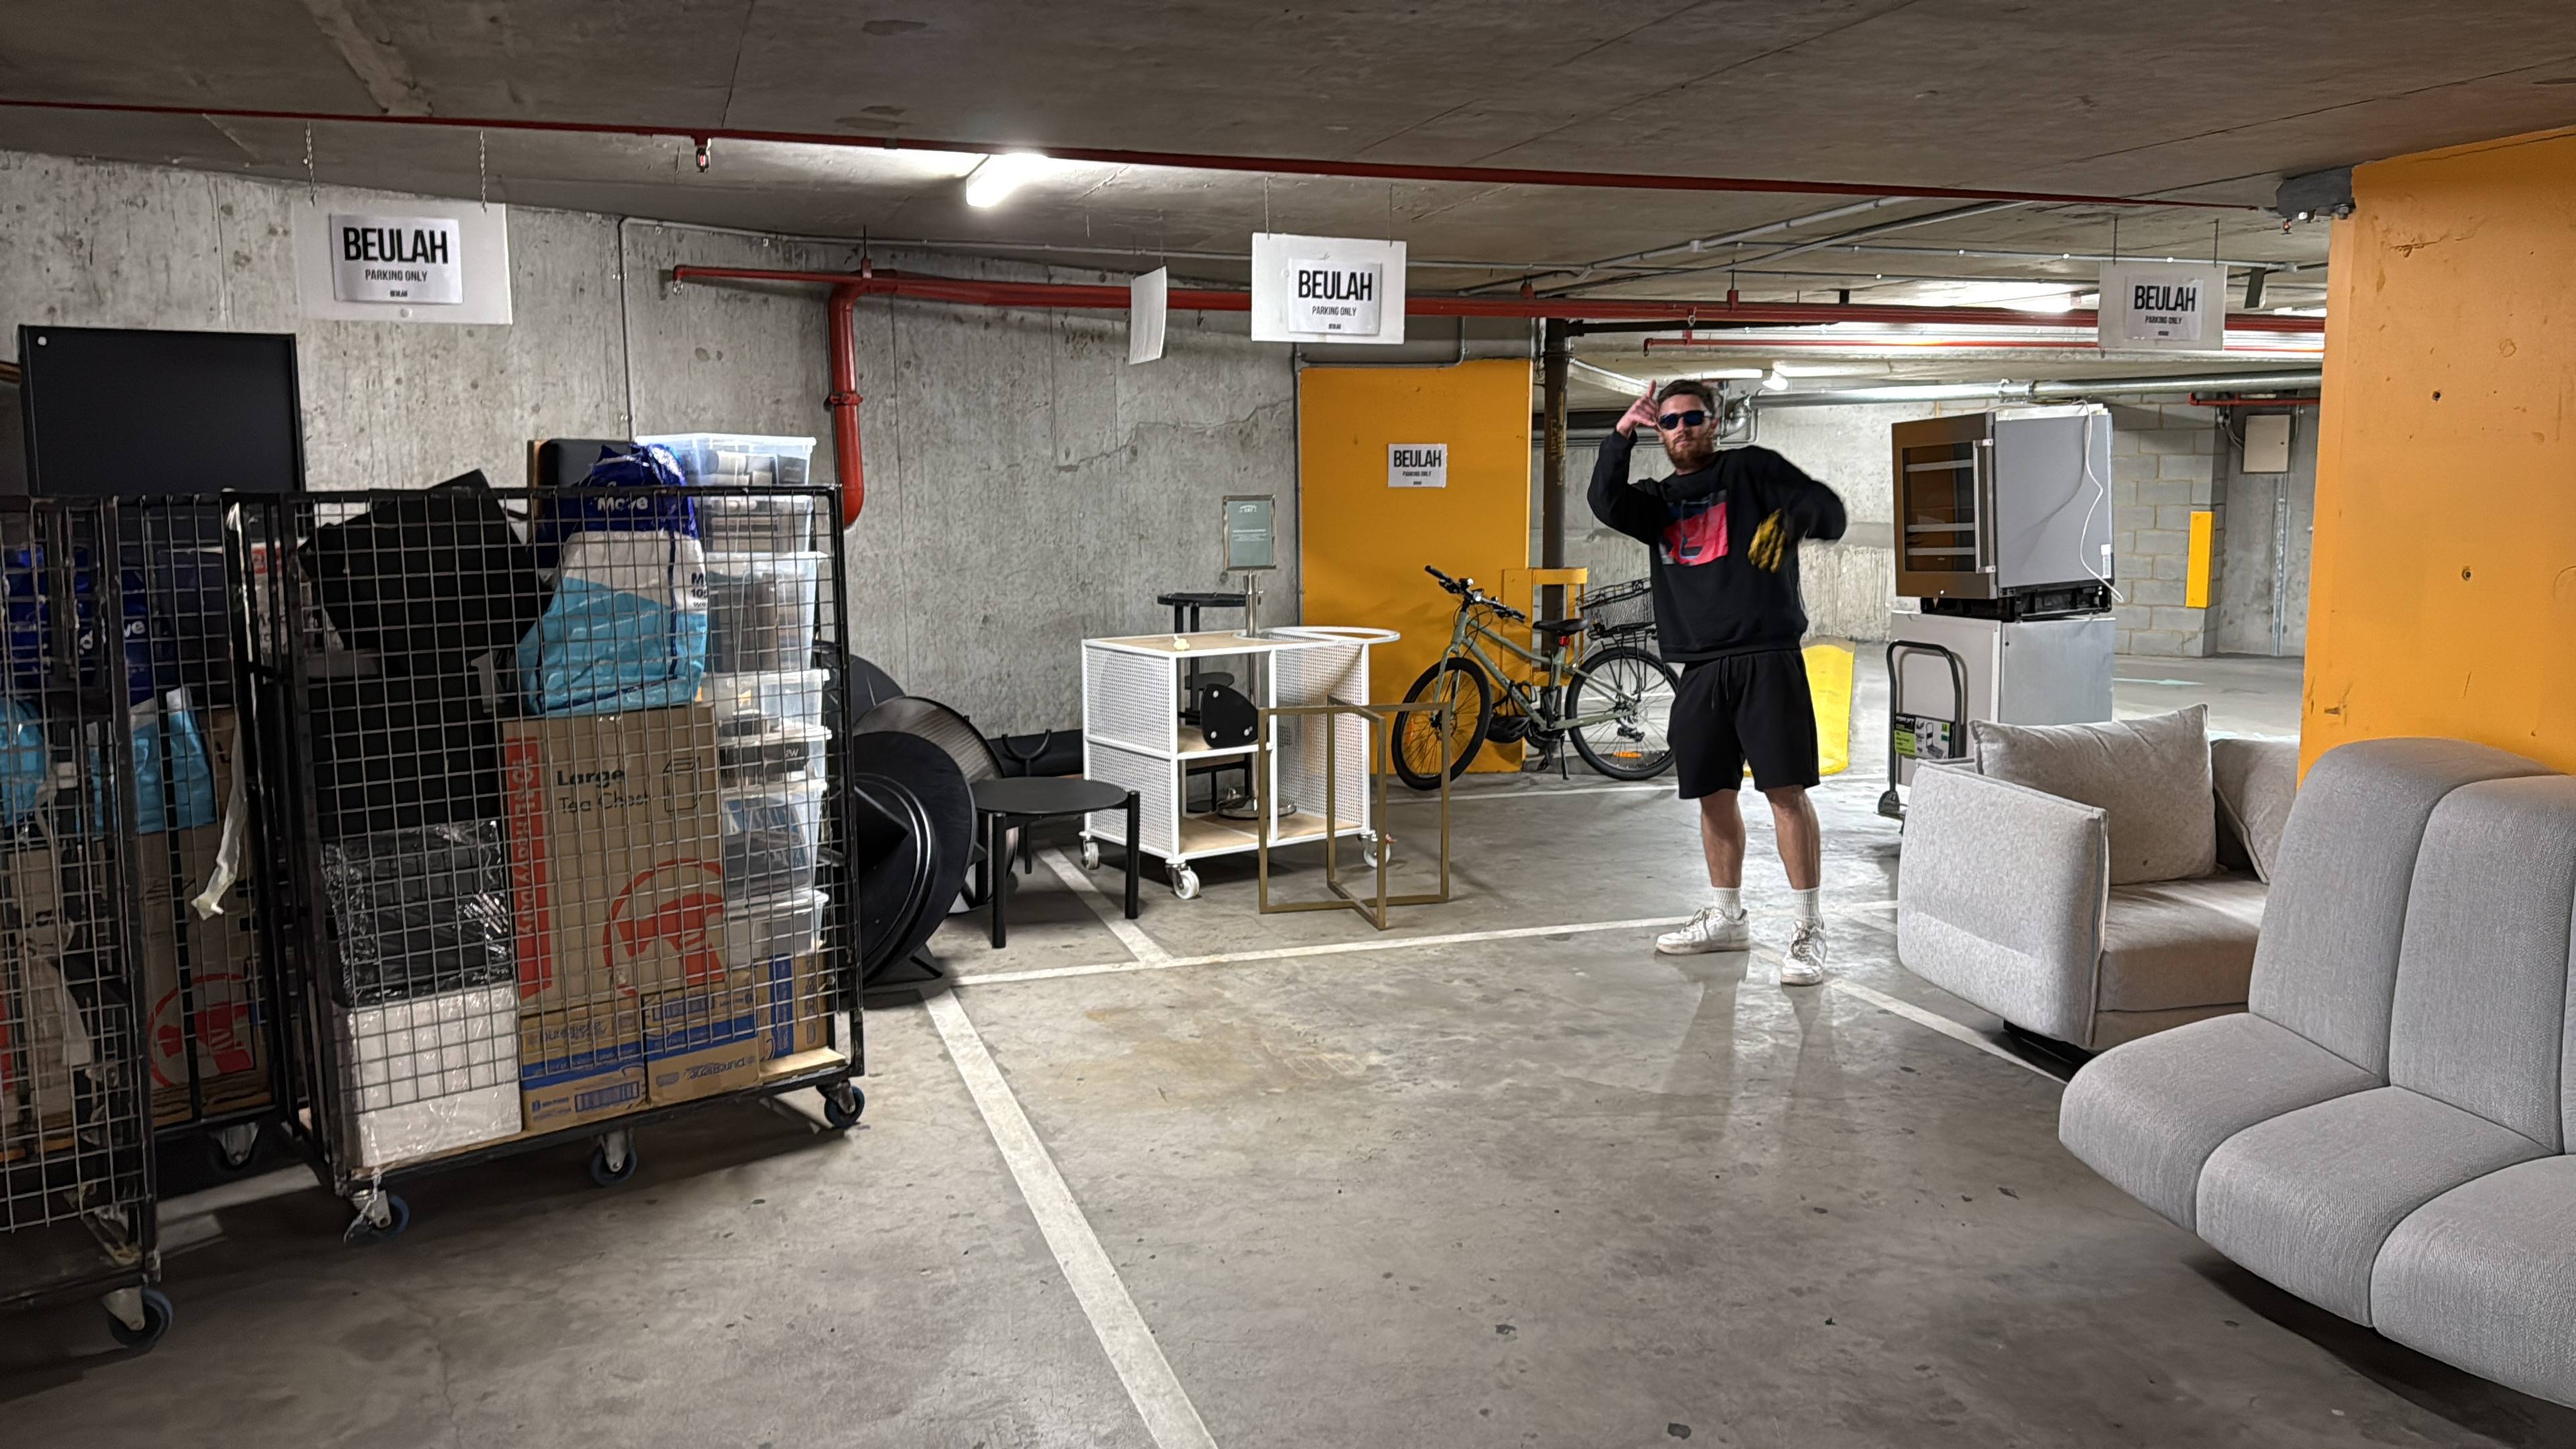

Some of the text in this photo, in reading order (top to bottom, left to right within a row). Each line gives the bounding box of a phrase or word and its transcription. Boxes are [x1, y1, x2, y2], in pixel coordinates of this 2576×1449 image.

[343, 227, 449, 264] BEULAH
[365, 269, 427, 282] PARKING ONLY
[1298, 270, 1373, 301] BEULAH
[2134, 285, 2197, 312] BEULAH
[1311, 305, 1357, 317] PARKING ONLY
[2145, 315, 2182, 325] PARKING ONLY
[1393, 450, 1442, 468] BEULAH
[557, 769, 625, 788] Large
[558, 790, 649, 813] Tea Chest
